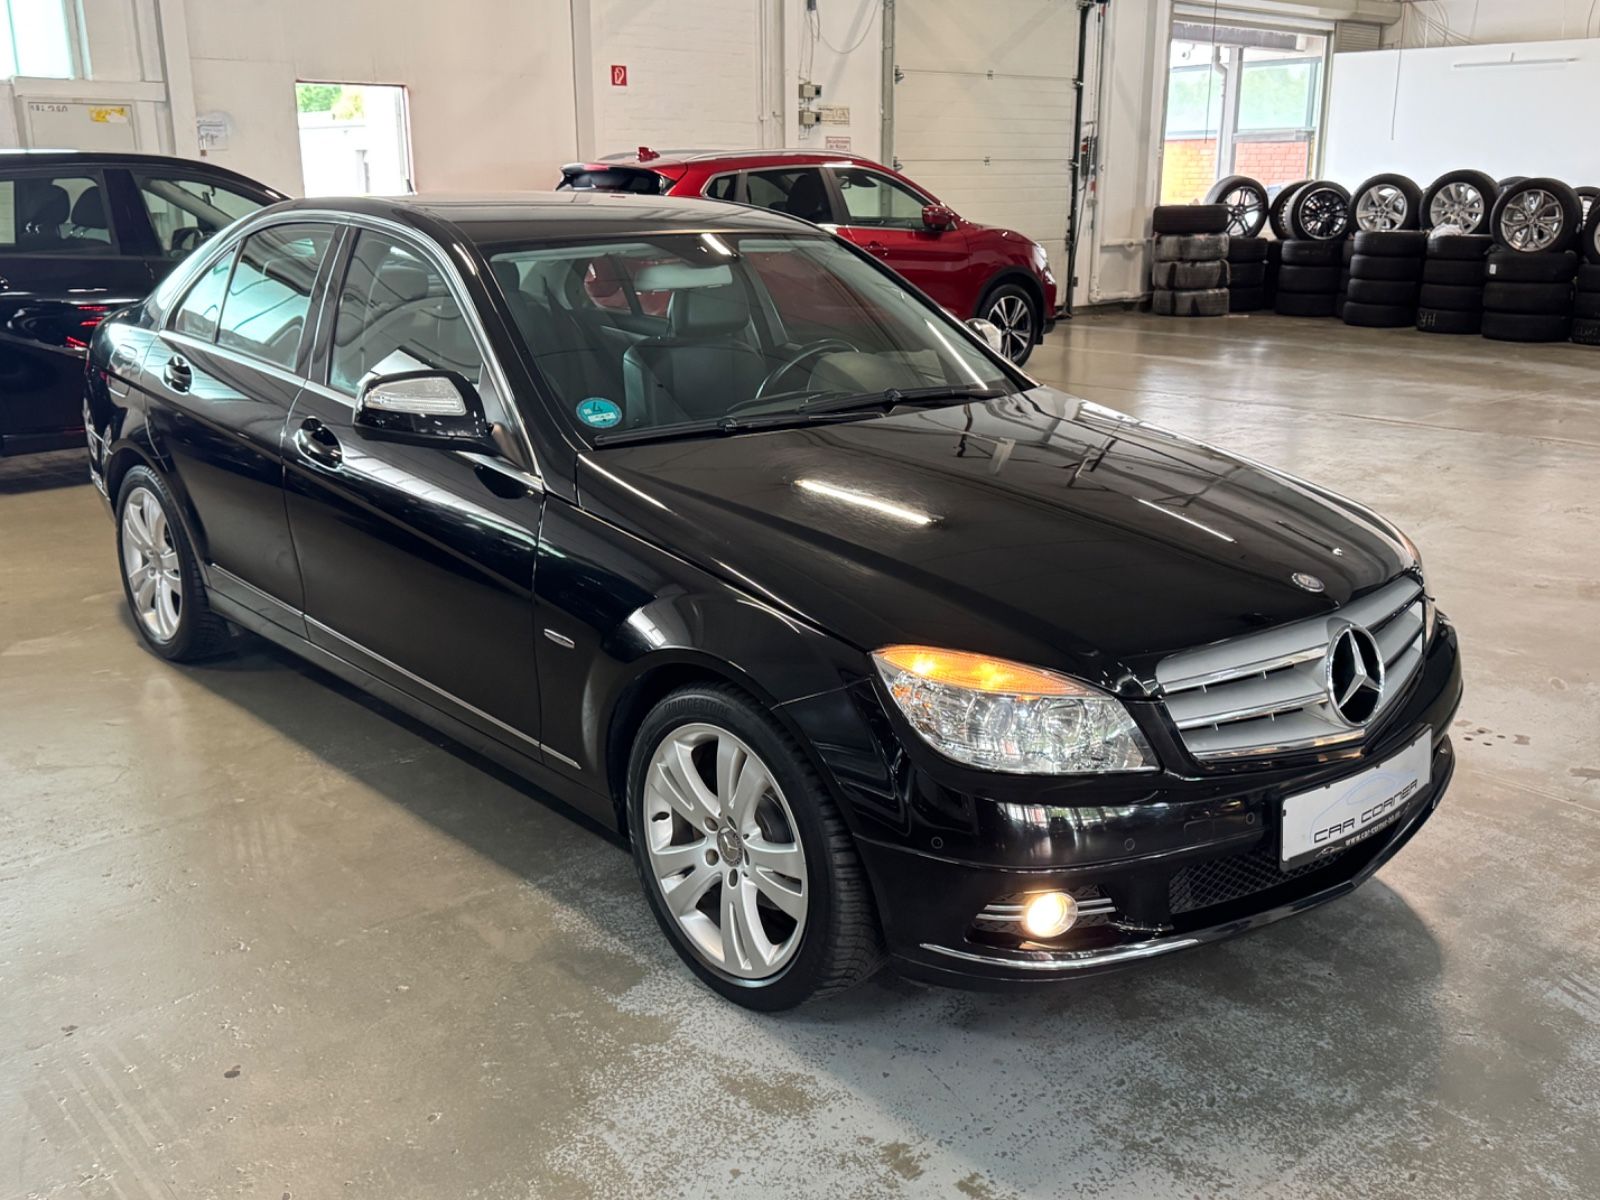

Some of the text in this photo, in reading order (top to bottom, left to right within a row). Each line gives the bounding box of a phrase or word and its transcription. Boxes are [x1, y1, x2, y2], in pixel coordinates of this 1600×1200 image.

[592, 401, 604, 414] 4
[1313, 778, 1418, 844] CAR CORNER
